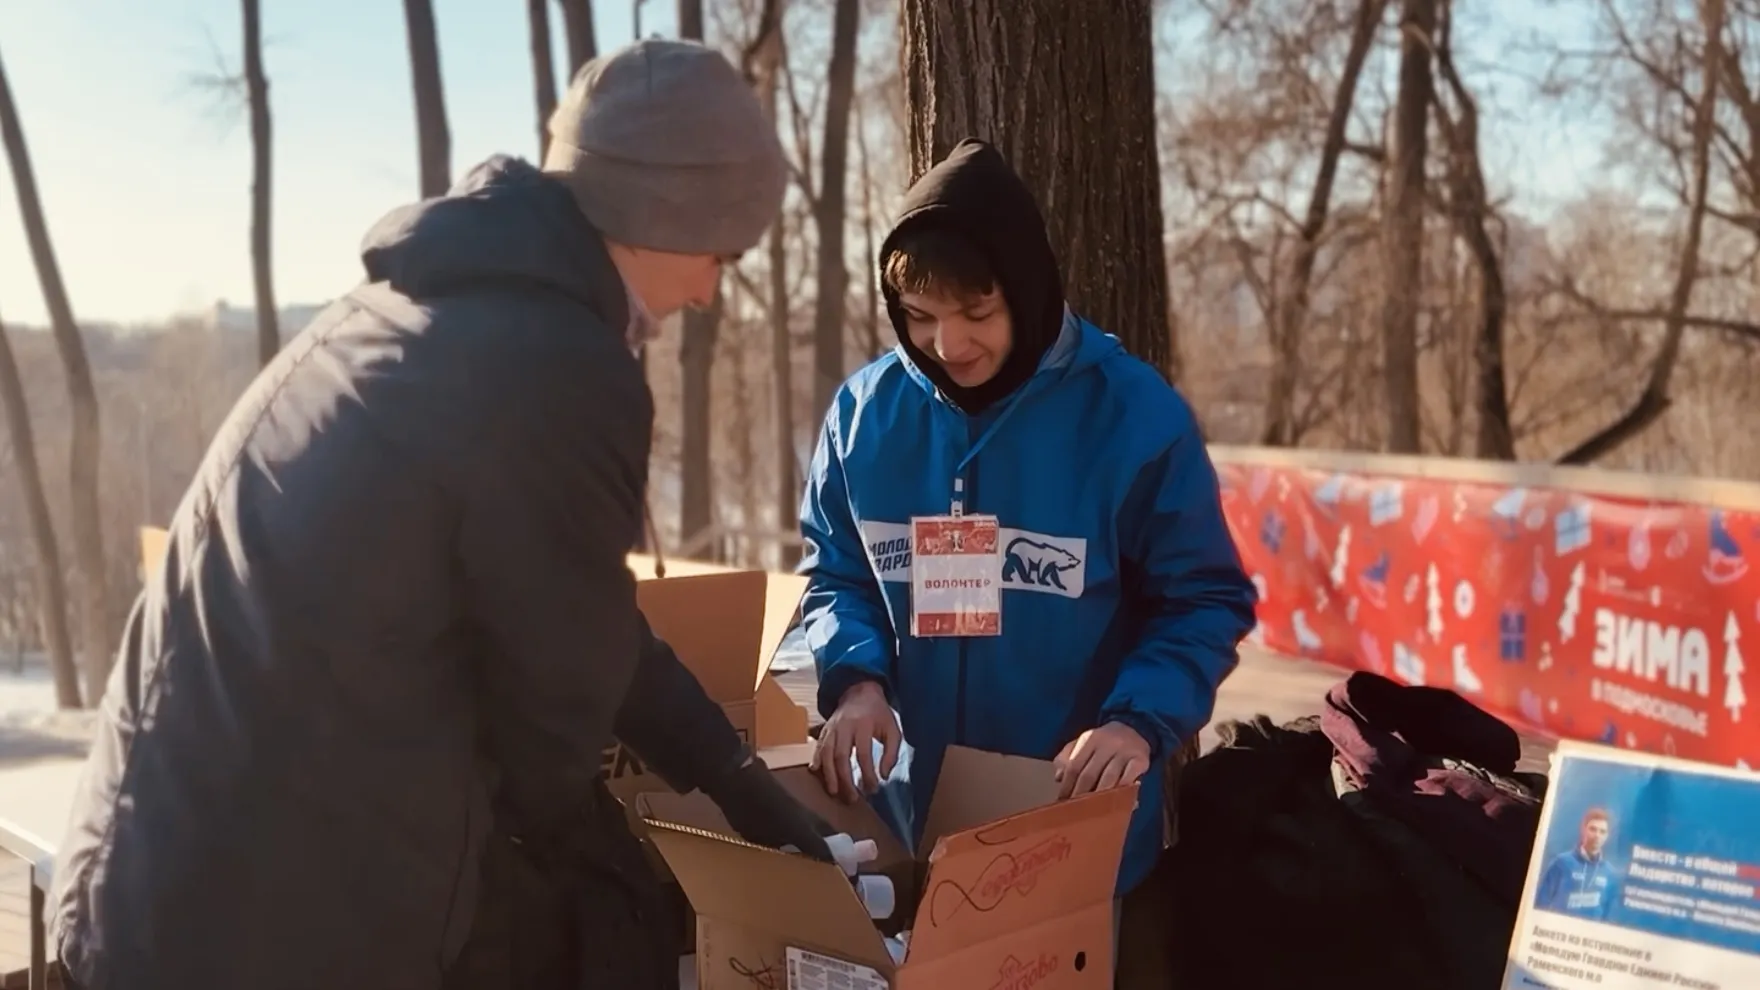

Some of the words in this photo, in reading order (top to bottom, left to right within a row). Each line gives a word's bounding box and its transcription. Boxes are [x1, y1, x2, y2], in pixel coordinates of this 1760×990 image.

[925, 578, 991, 589] ВОЛОНТЕР
[1592, 607, 1710, 698] ЗИМА
[1532, 925, 1567, 944] Анкета
